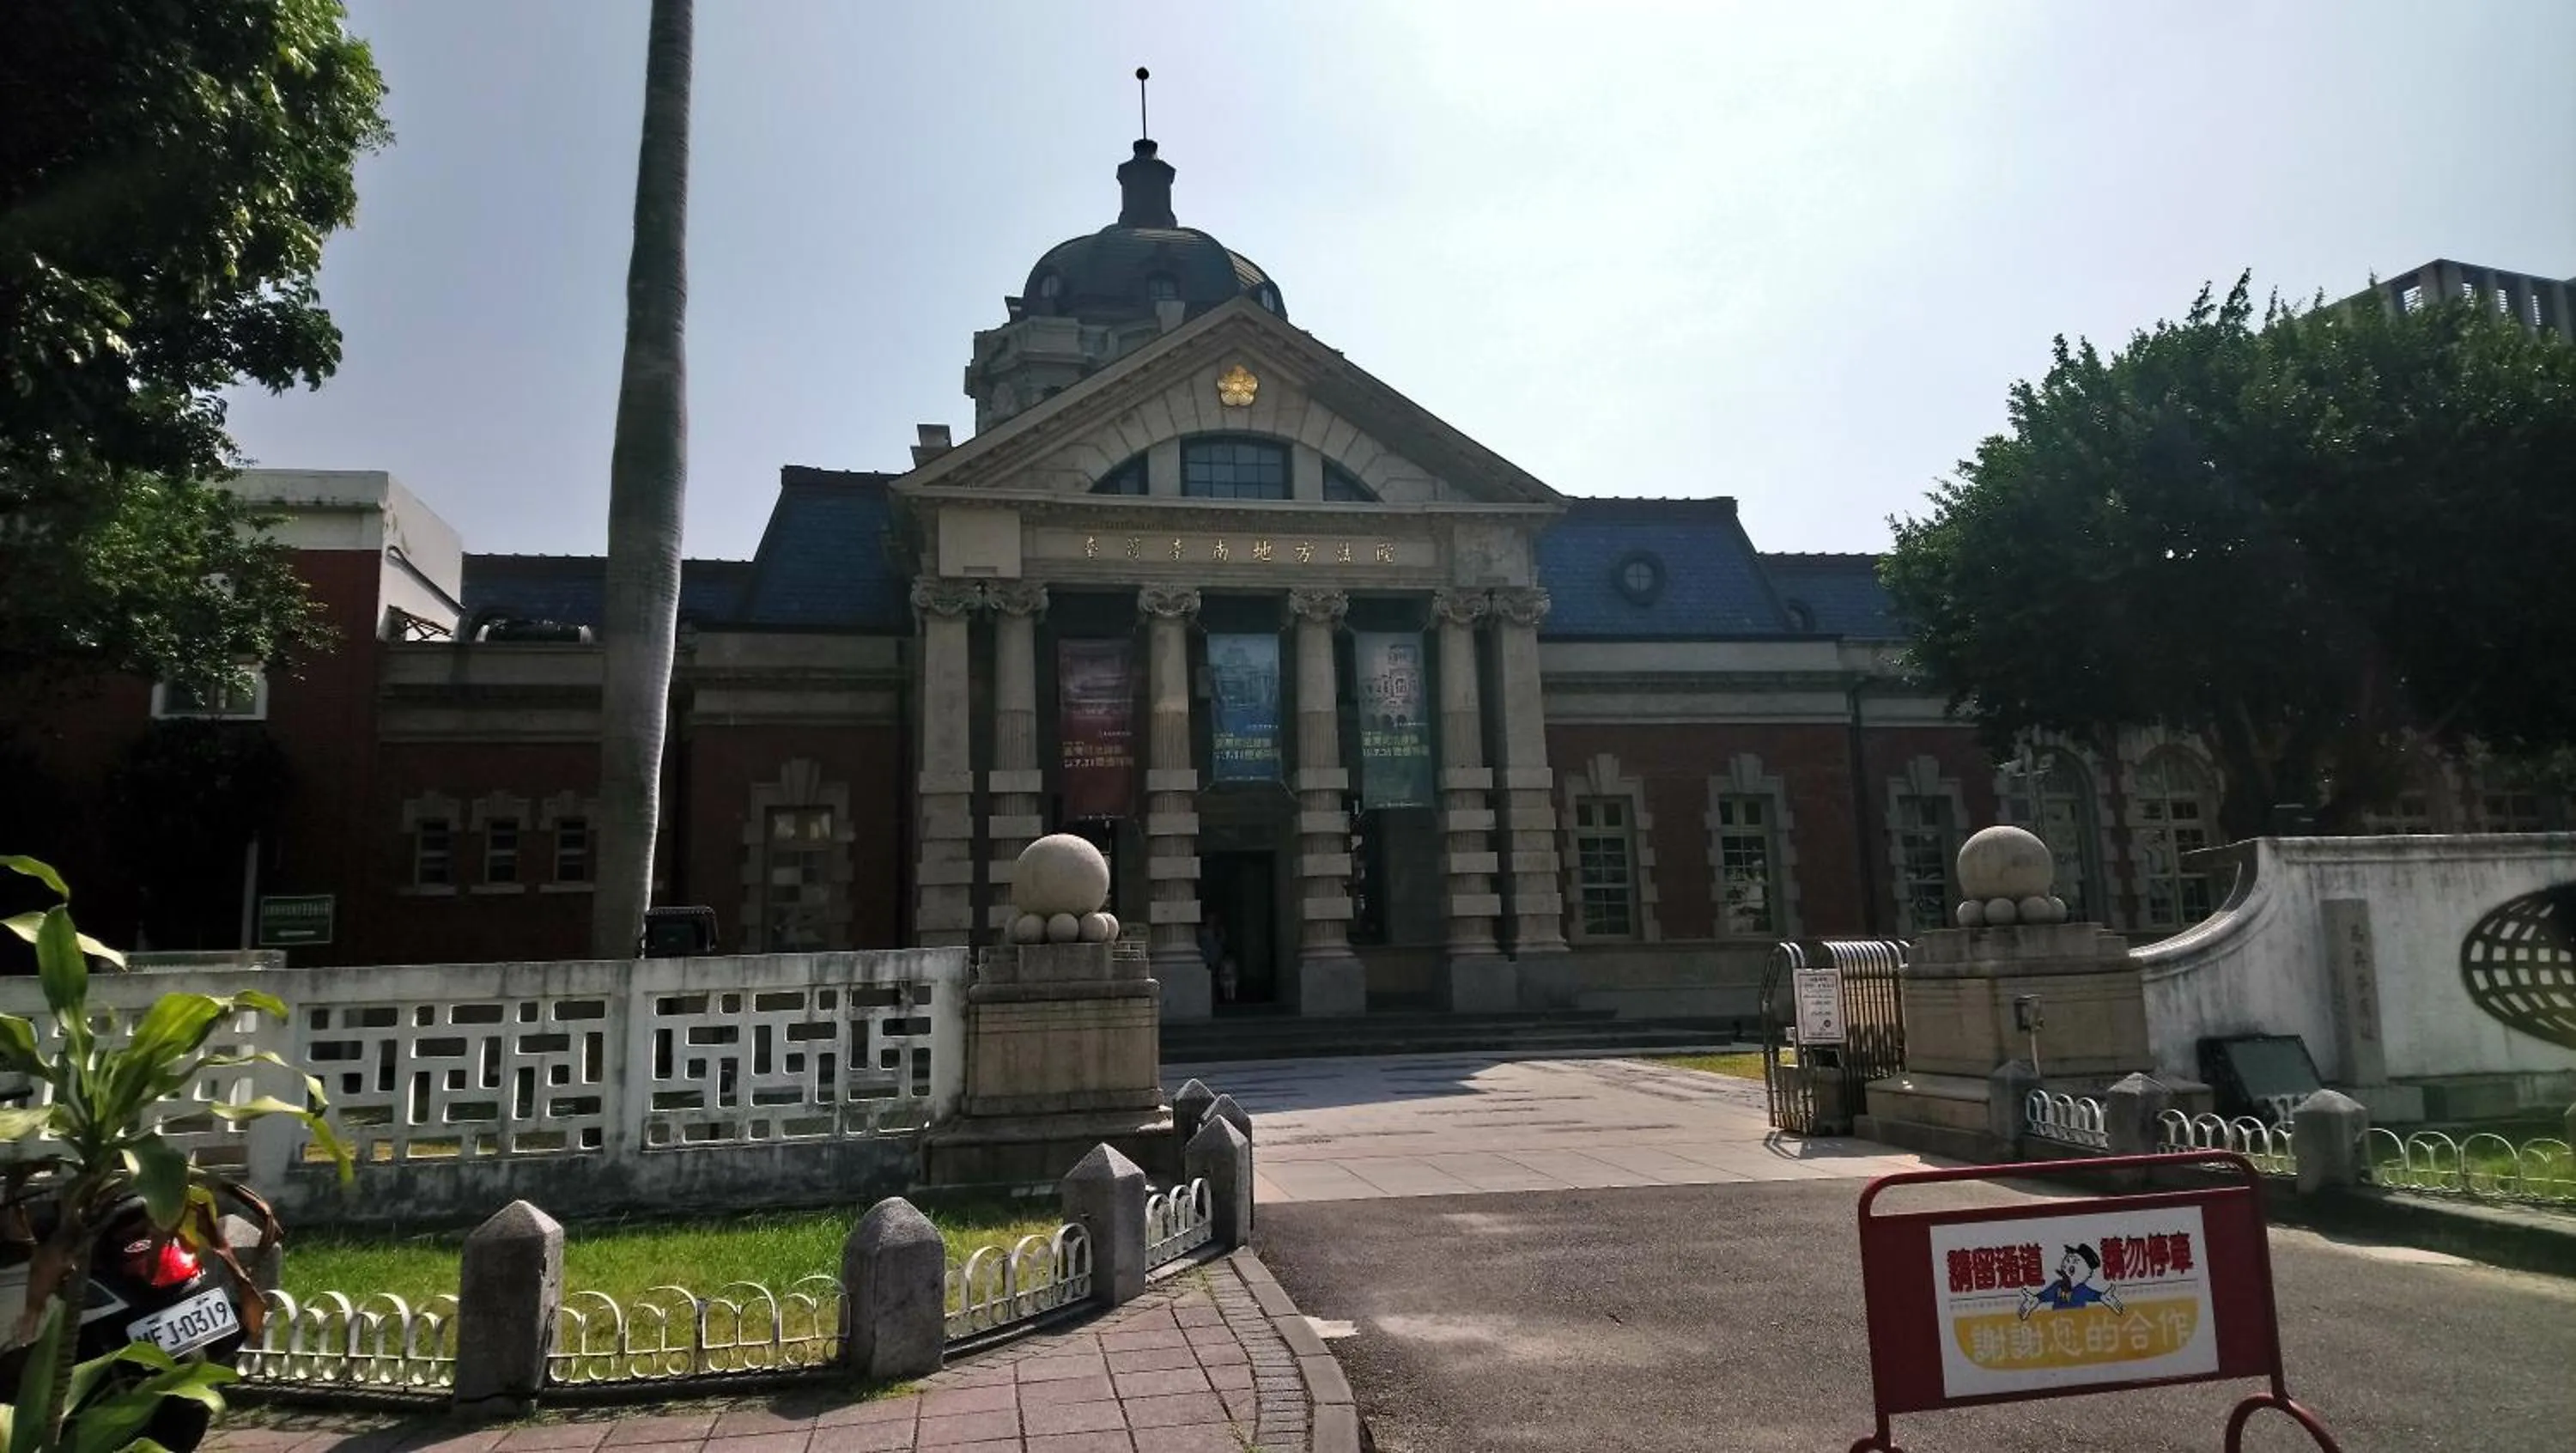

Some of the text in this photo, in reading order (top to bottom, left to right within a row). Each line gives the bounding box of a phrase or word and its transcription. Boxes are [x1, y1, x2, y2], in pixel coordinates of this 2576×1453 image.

[2100, 1231, 2194, 1281] 請勿停車
[1971, 1310, 2191, 1362] 謝謝您的合作
